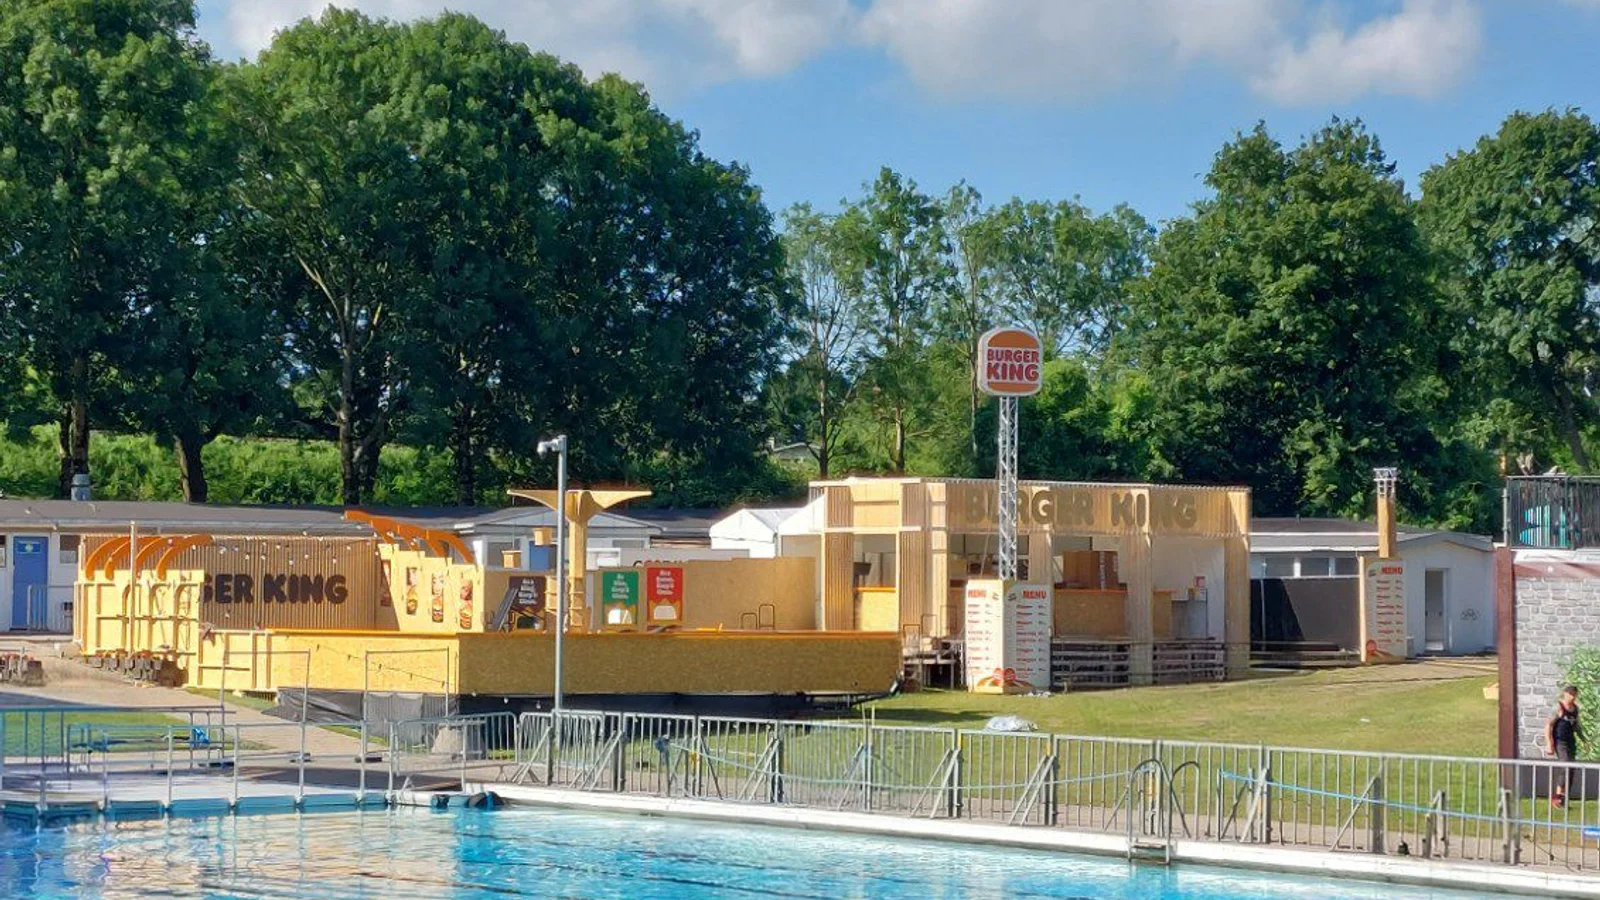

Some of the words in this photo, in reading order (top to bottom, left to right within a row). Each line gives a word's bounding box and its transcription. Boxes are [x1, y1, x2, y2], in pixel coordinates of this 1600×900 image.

[987, 349, 1040, 363] BURGER
[987, 362, 1040, 382] KING
[1110, 490, 1198, 529] KING
[1381, 566, 1403, 576] MENU
[263, 573, 348, 604] KING
[1022, 589, 1047, 599] MENU
